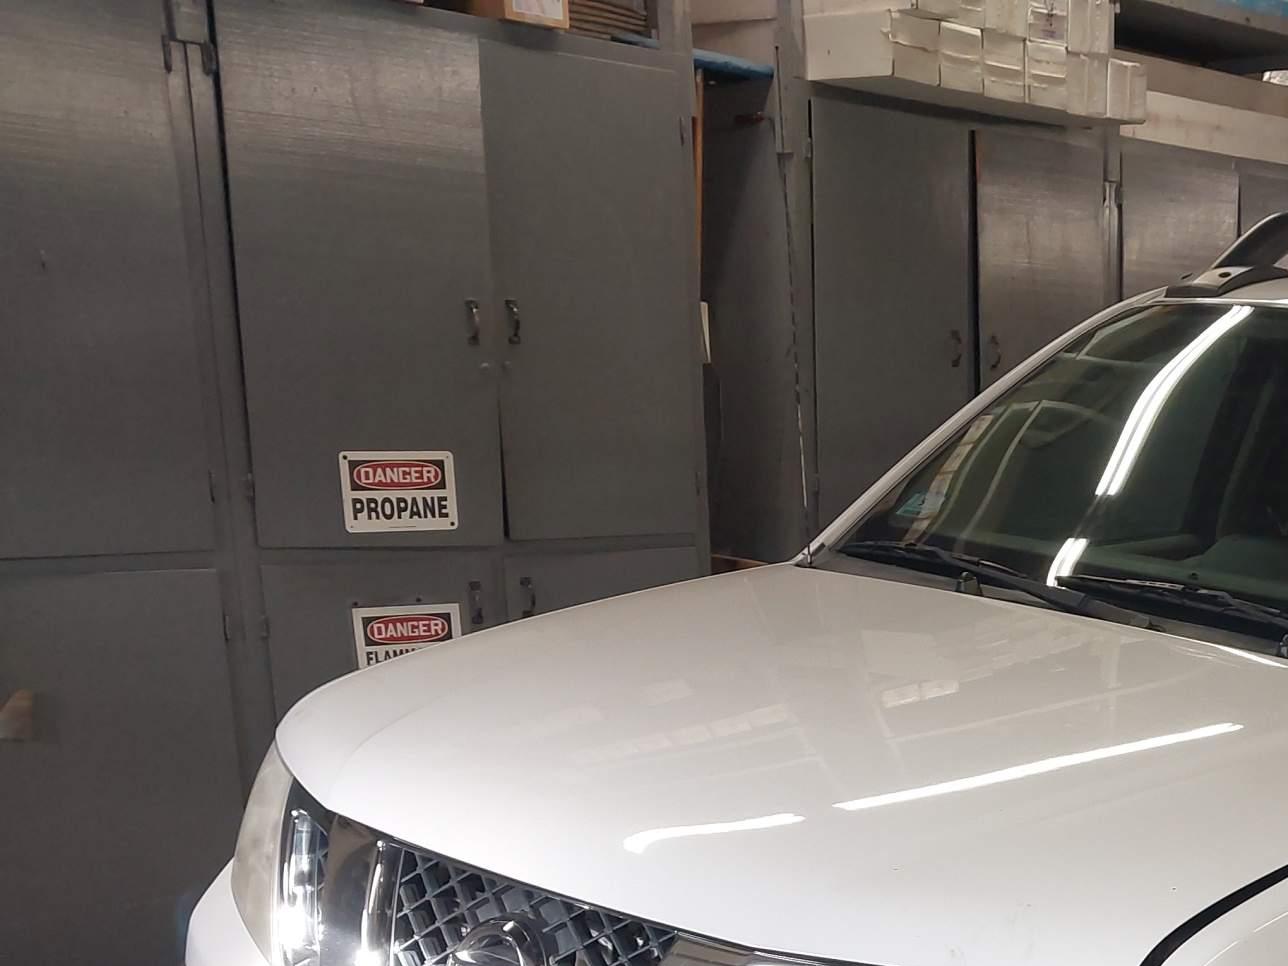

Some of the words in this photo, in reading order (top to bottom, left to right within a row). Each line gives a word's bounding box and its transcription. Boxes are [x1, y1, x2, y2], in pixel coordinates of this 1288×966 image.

[360, 467, 436, 484] DANGER
[351, 496, 449, 520] PROPANE
[373, 620, 443, 639] DANGER
